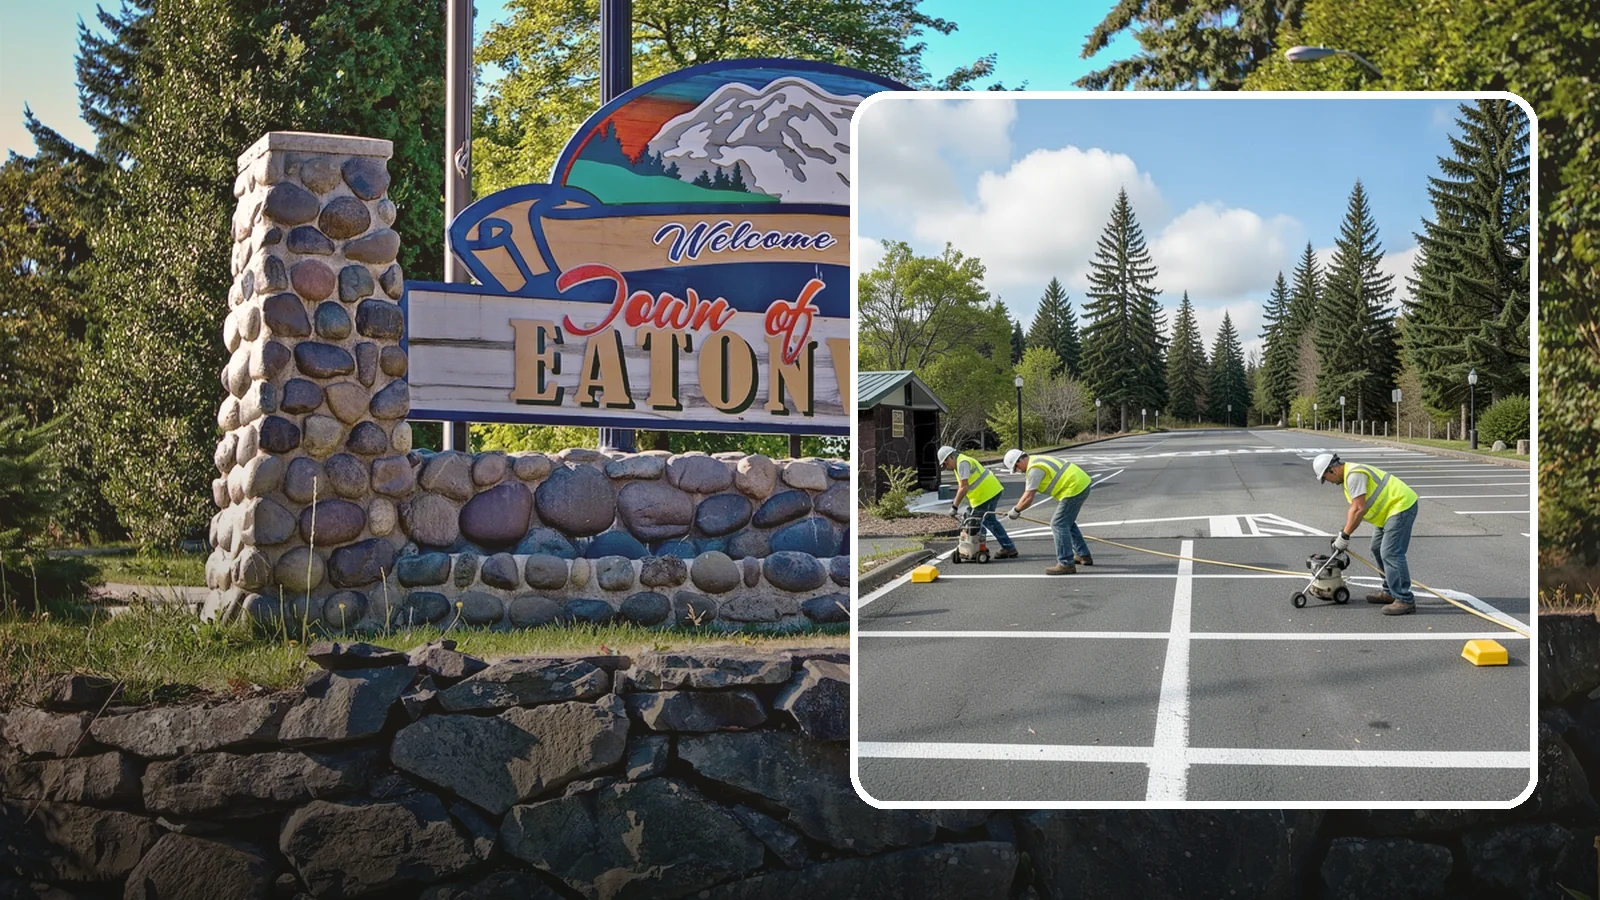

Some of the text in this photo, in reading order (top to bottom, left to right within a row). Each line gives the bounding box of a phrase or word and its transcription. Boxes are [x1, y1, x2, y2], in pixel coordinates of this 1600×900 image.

[653, 221, 837, 262] Welcome
[557, 264, 826, 365] Town of
